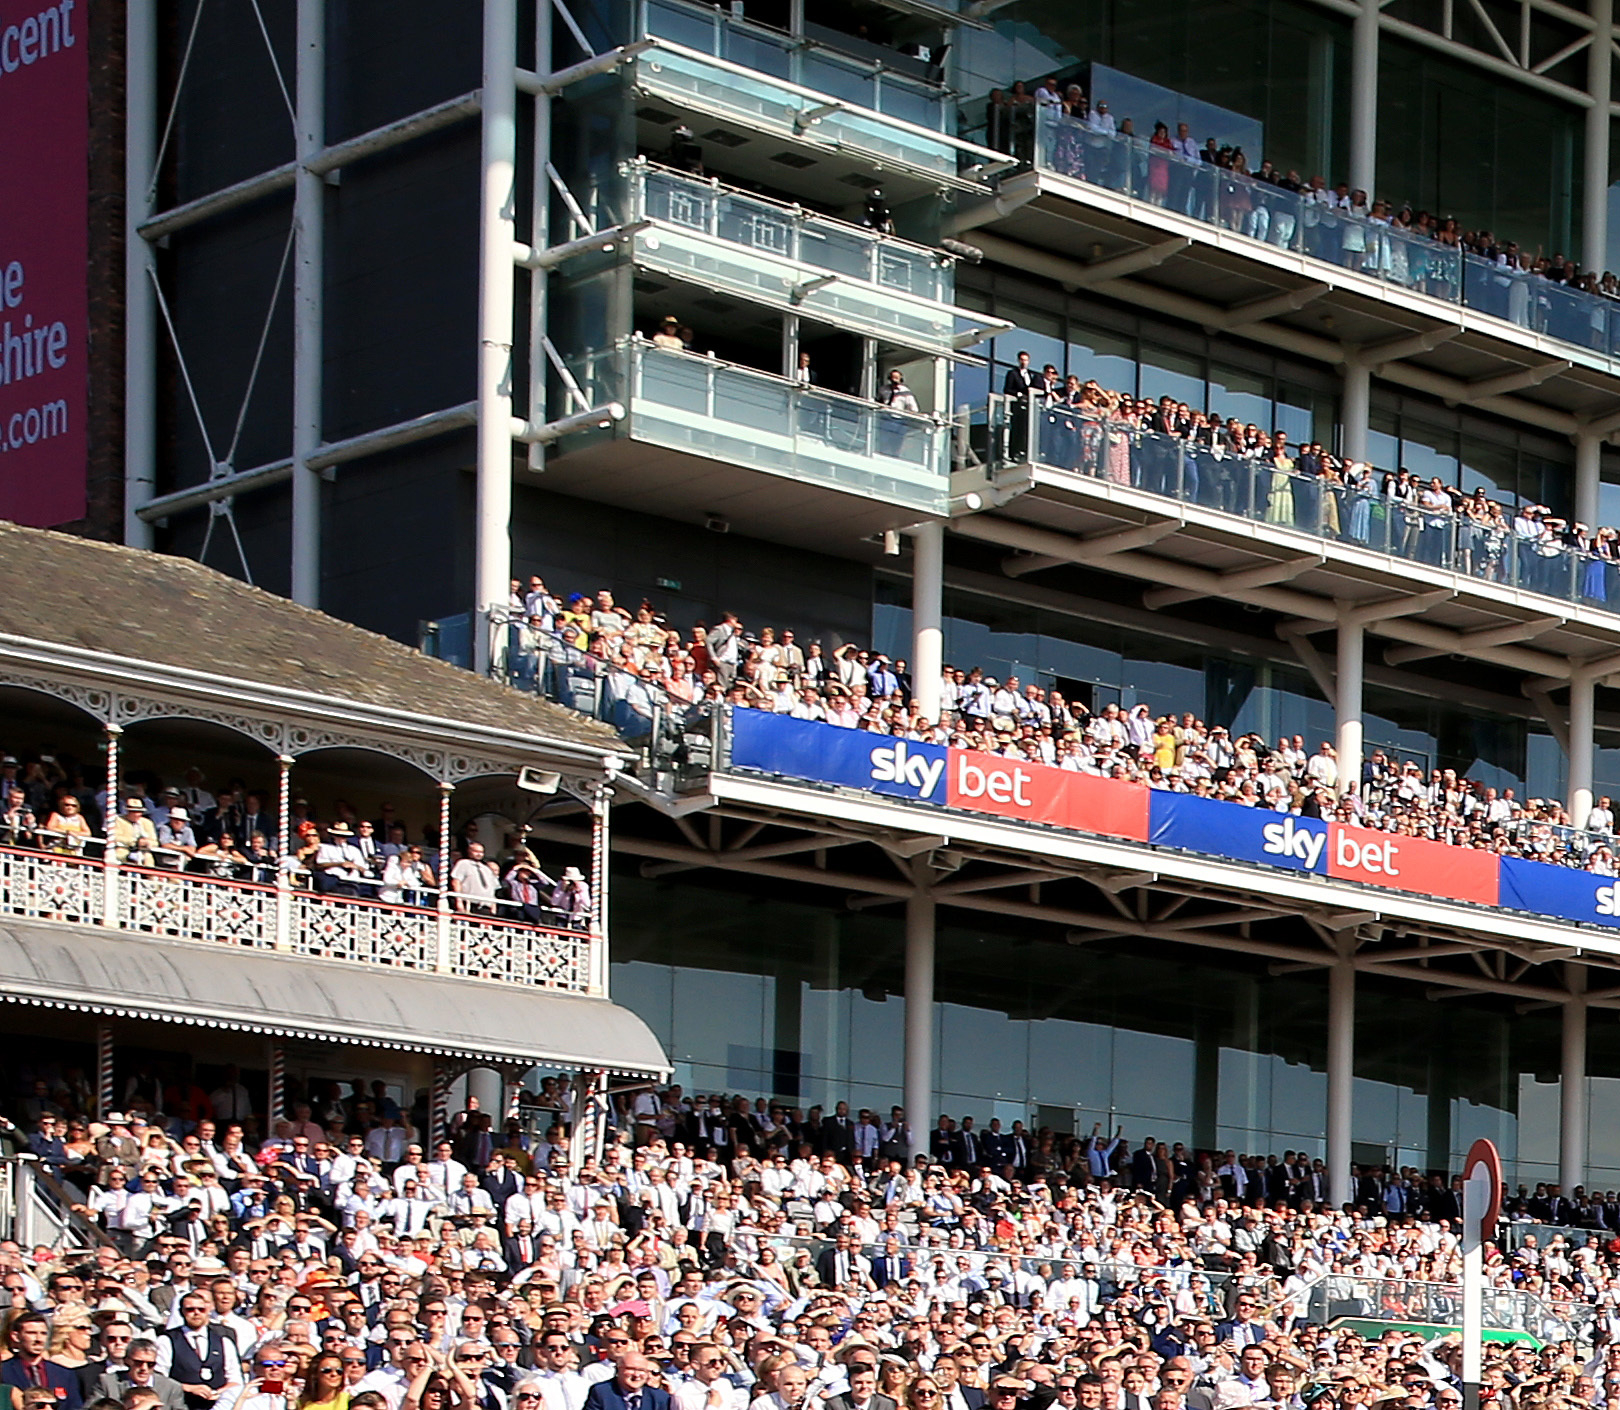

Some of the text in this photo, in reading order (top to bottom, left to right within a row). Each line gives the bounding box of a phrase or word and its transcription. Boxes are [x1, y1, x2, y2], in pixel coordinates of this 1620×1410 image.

[0, 0, 76, 78] cent
[0, 314, 68, 386] hire
[0, 399, 68, 451] .com
[871, 741, 1032, 807] sky bet
[1263, 817, 1400, 876] sky bet
